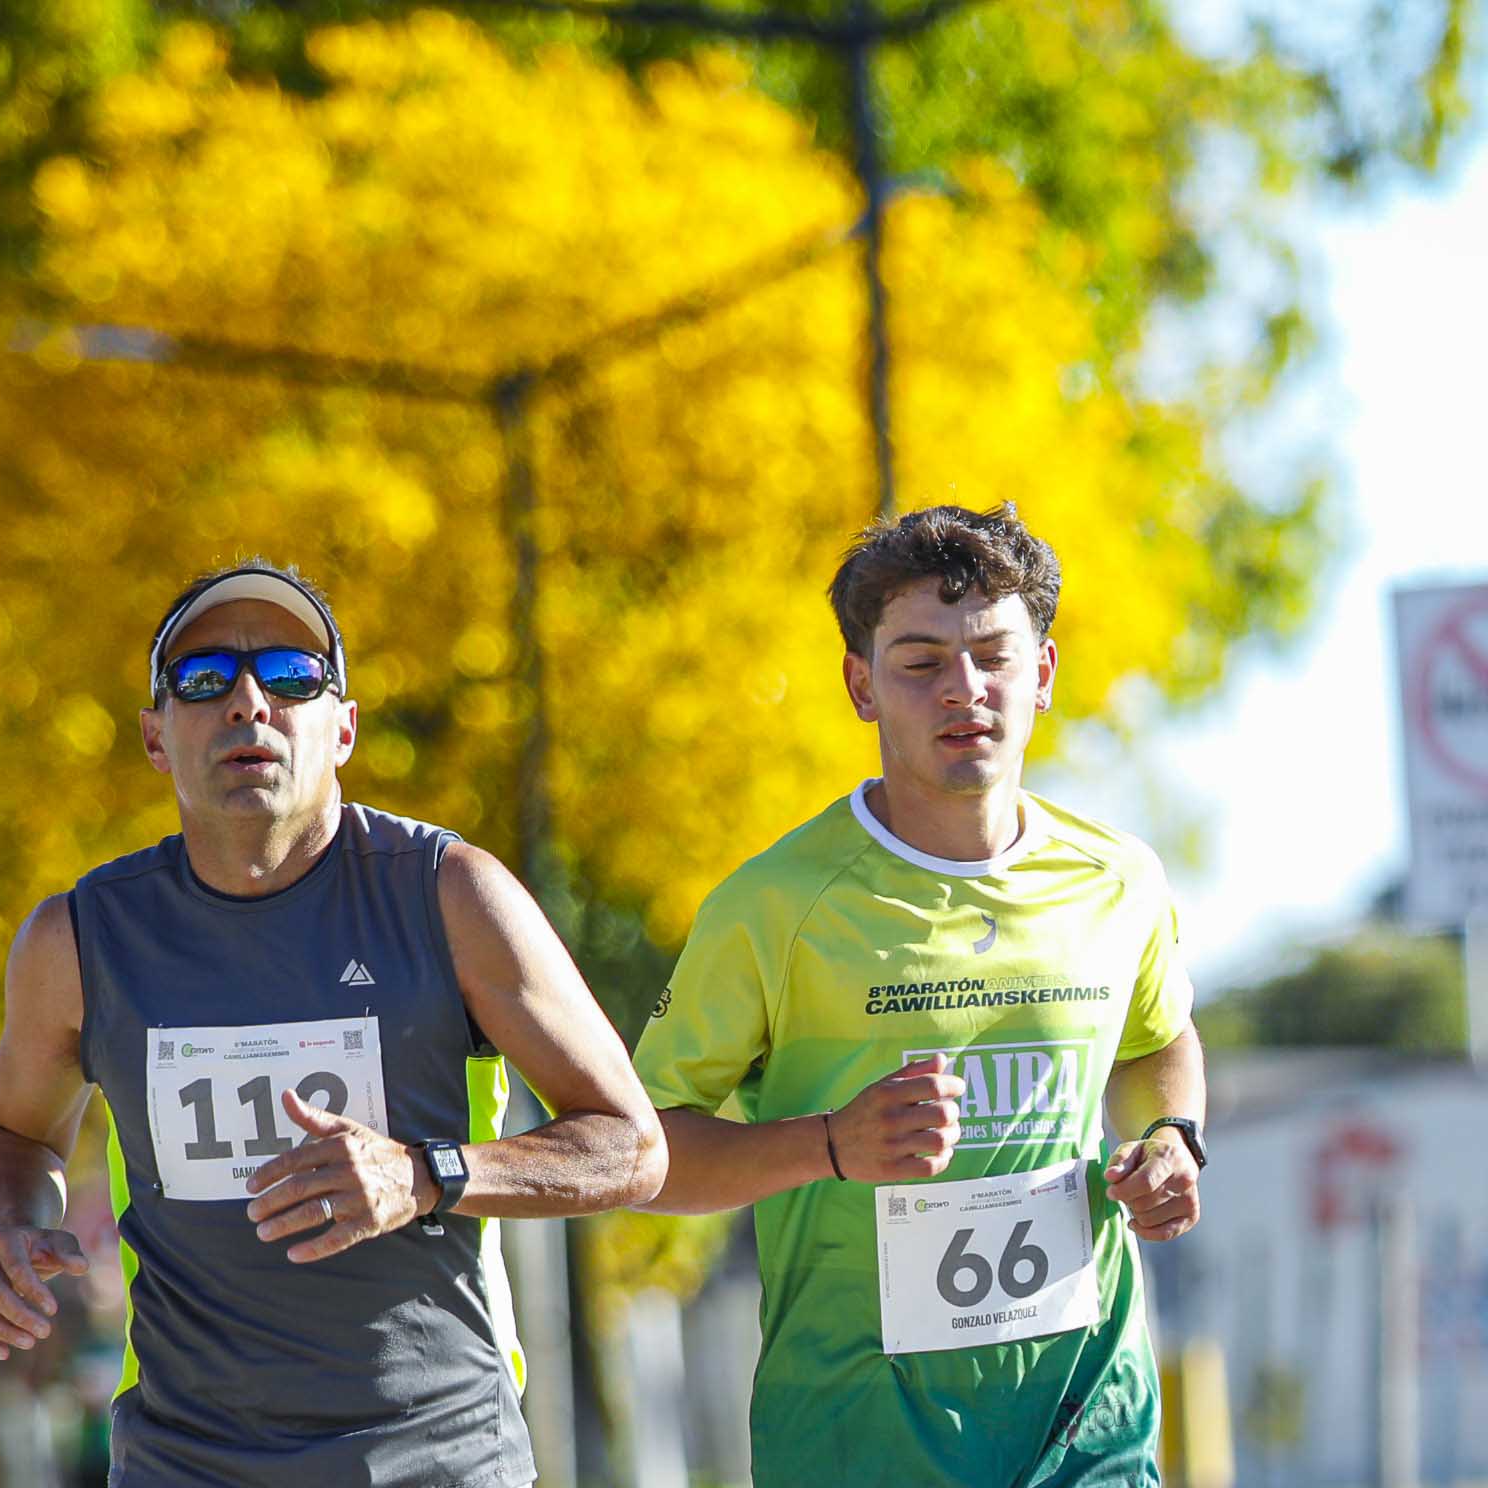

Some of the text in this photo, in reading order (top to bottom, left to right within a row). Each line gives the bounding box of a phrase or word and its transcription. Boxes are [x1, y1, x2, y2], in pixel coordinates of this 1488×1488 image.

[865, 985, 1111, 1015] CAWILLIAMSKEMMIS
[177, 1071, 349, 1161] 112
[944, 1050, 1080, 1118] AIRA
[936, 1219, 1049, 1308] 66
[952, 1305, 1038, 1329] GONZALO VELAZQUEZ
